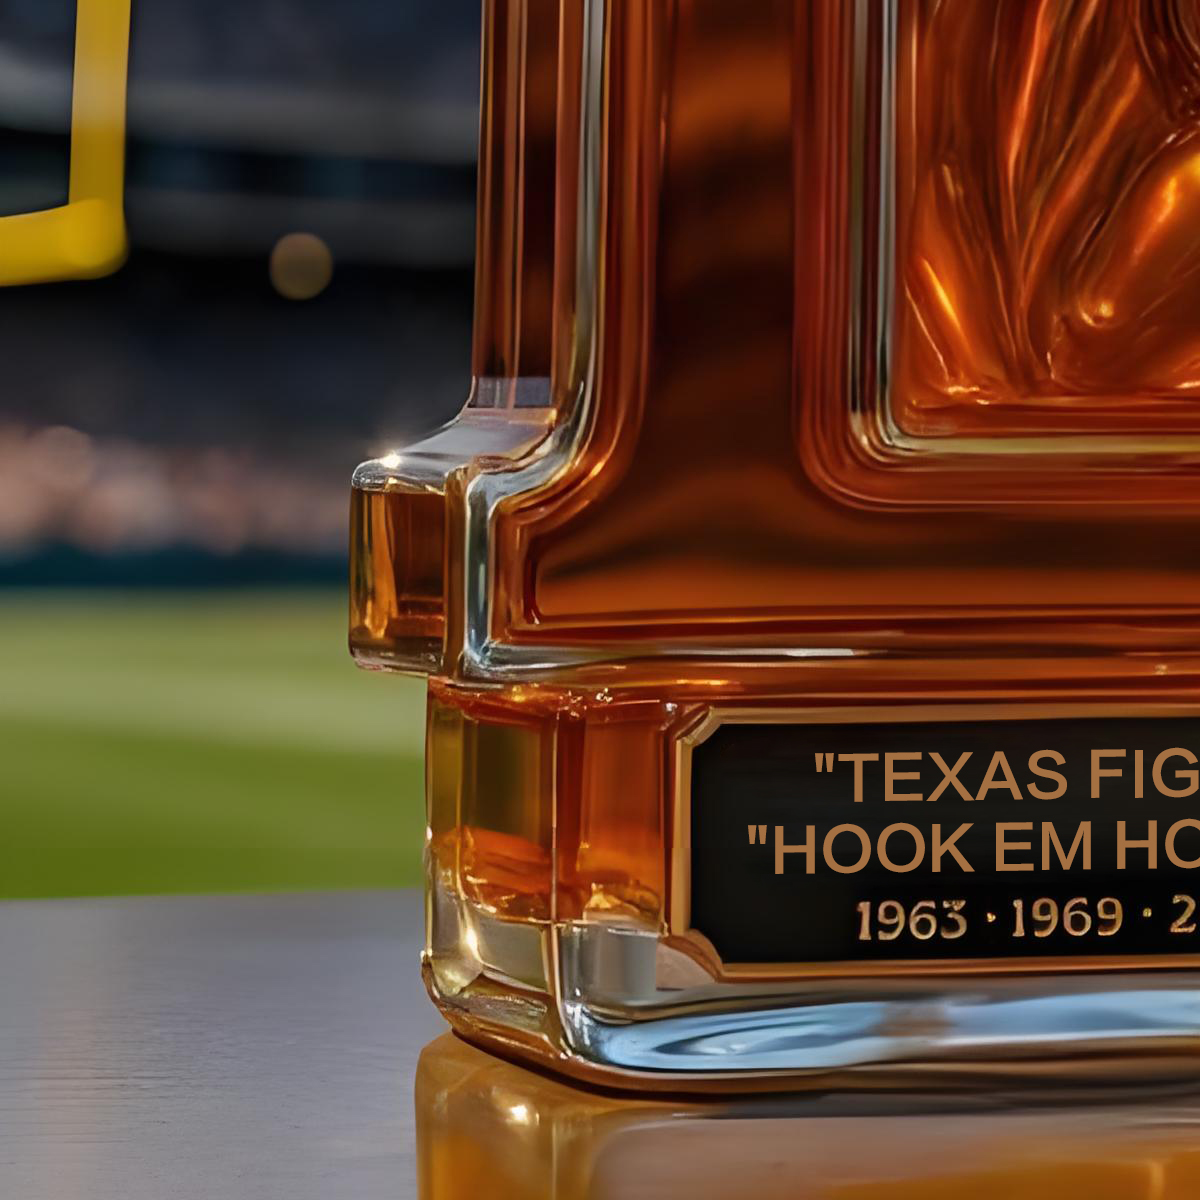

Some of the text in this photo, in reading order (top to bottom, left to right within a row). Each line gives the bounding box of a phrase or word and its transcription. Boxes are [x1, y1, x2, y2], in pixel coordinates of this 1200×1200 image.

[814, 750, 1068, 803] "TEXAS
[747, 822, 975, 875] "HOOK
[995, 820, 1092, 872] EM
[857, 899, 967, 941] 1963
[1012, 897, 1123, 938] 1969
